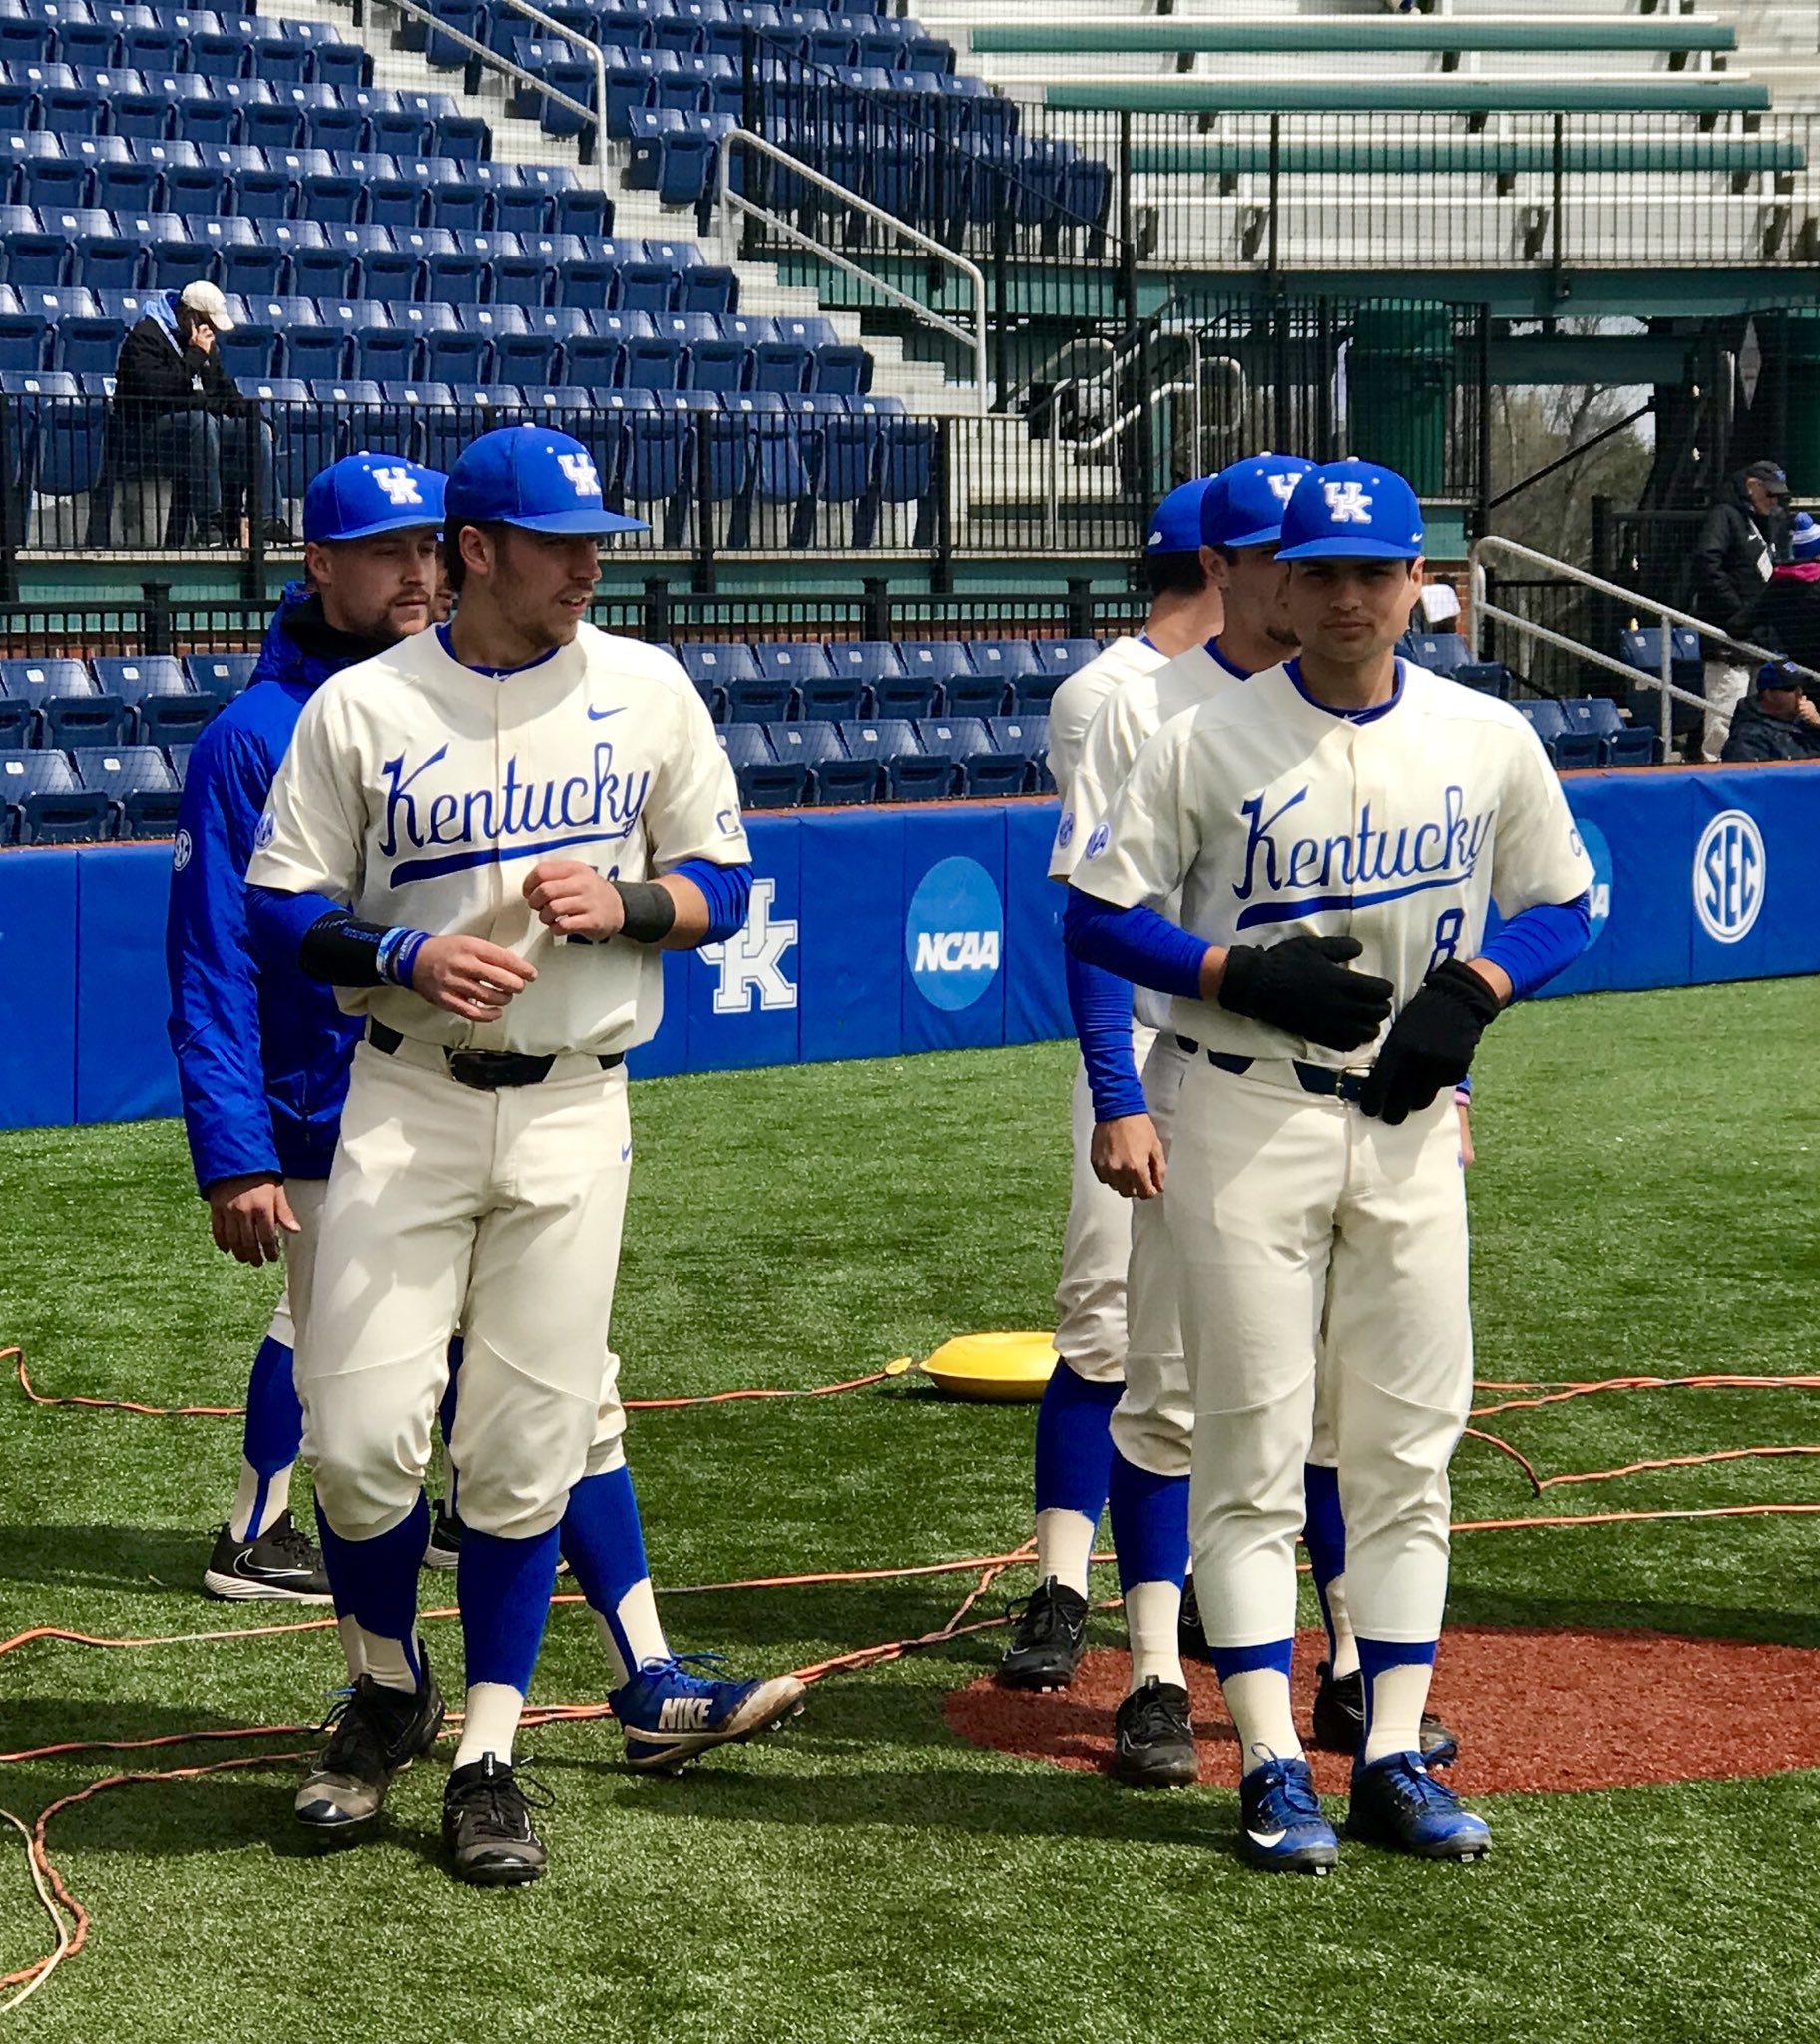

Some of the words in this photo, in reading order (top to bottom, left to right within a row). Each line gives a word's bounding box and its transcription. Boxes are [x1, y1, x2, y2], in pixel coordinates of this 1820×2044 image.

[371, 466, 424, 505] UK
[557, 453, 601, 497] UK
[1323, 481, 1373, 524] UK
[378, 741, 651, 858] Kentucky
[1231, 784, 1496, 900] Kentucky
[1702, 821, 1758, 931] SEC
[914, 929, 1000, 973] NCAA
[658, 1697, 714, 1730] NIKE
